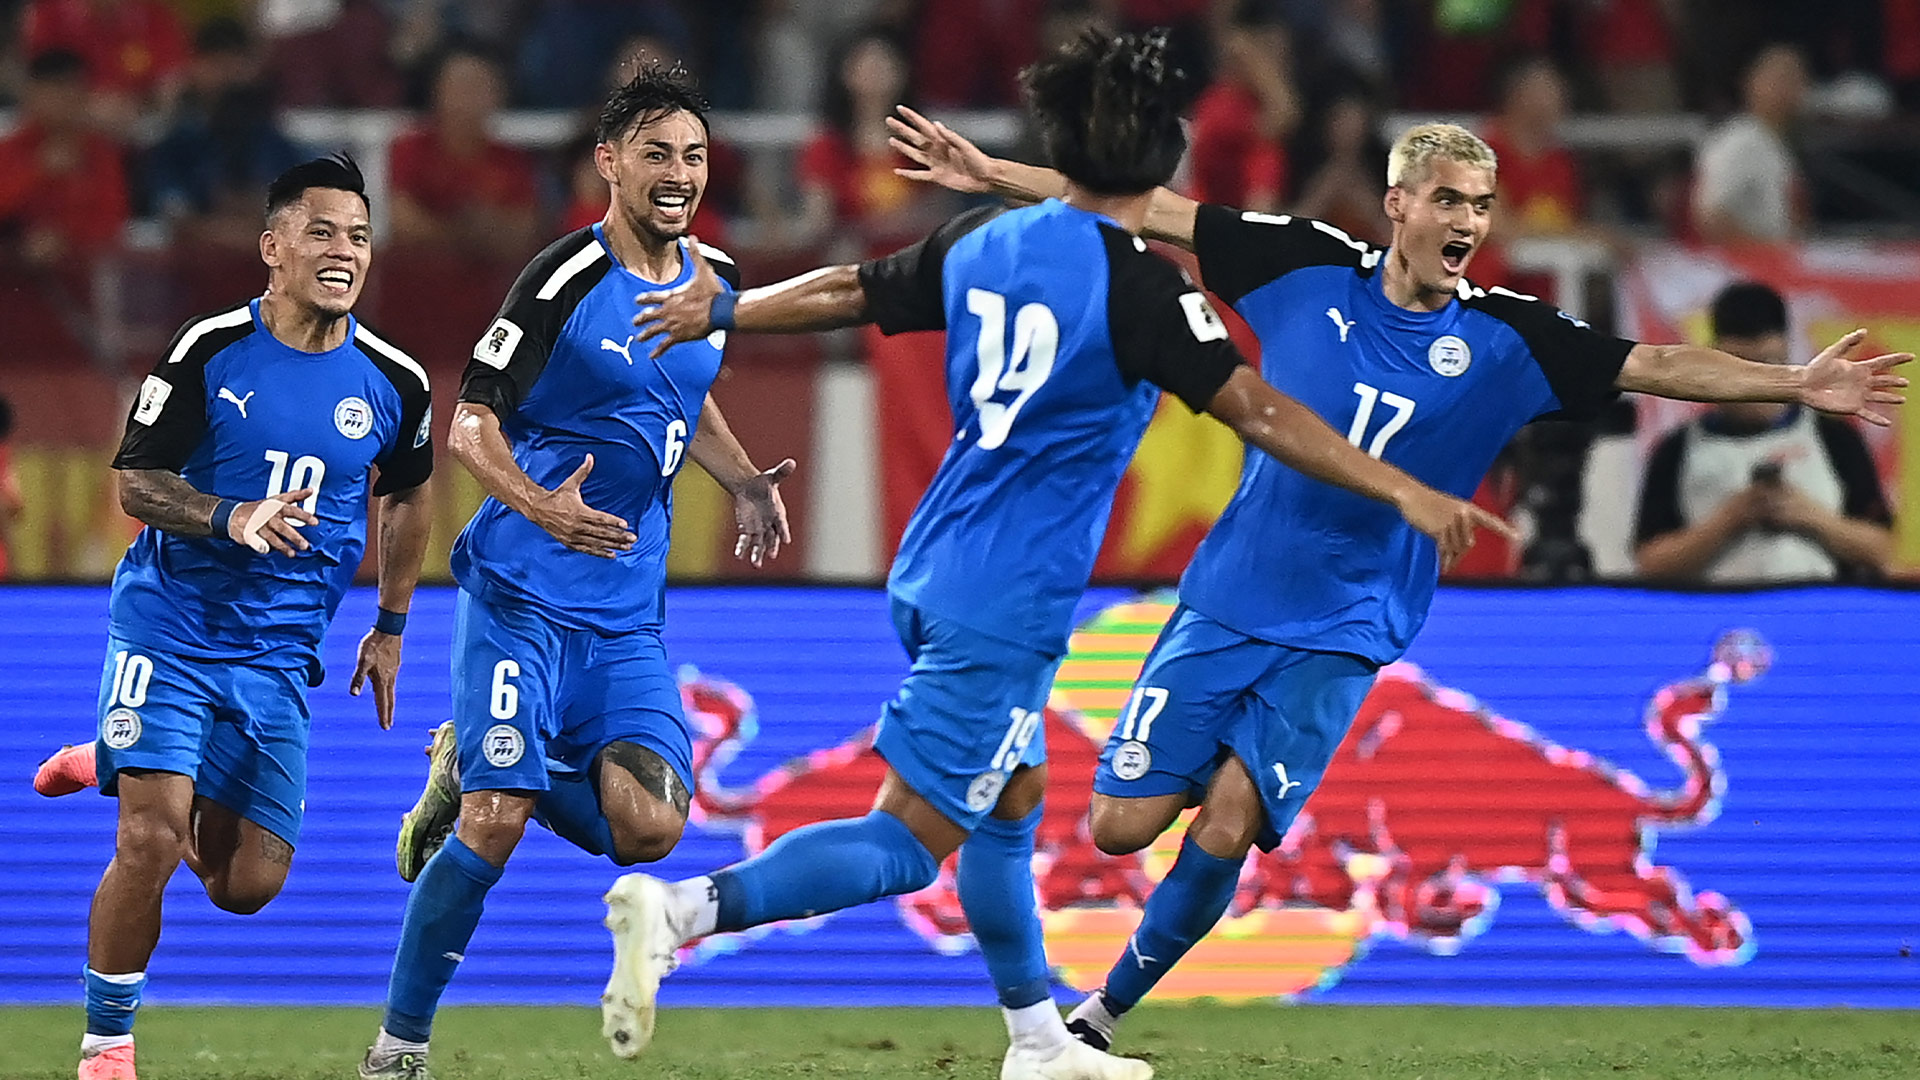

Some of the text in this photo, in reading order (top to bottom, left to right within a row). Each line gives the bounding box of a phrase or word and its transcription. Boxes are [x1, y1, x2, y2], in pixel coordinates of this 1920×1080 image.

[967, 287, 1059, 450] 19
[344, 419, 363, 428] PFF
[662, 419, 687, 477] 6
[1347, 382, 1416, 459] 17
[264, 449, 326, 527] 10
[109, 651, 154, 708] 10
[490, 659, 520, 720] 6
[112, 728, 131, 738] PFF
[990, 706, 1040, 772] 19
[1121, 687, 1170, 743] 17
[493, 748, 514, 756] PFF
